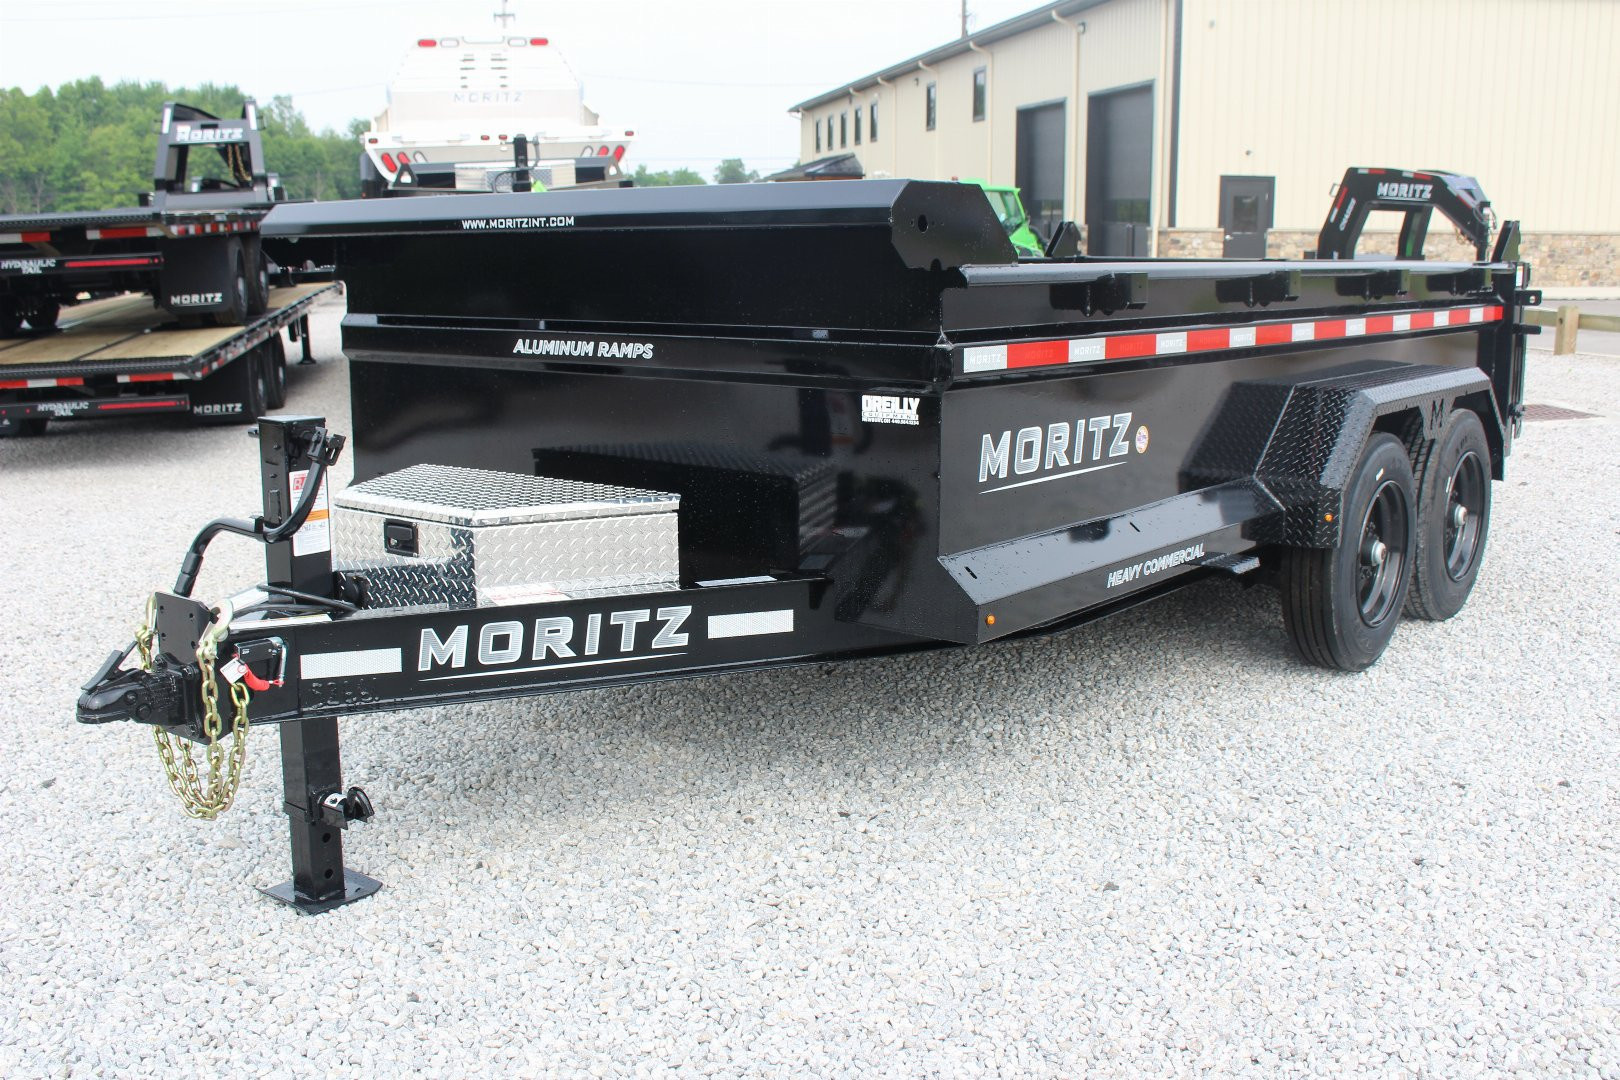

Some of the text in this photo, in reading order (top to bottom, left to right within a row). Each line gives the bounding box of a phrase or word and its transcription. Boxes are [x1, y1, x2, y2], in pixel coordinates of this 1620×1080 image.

[453, 91, 523, 103] MORITZ
[176, 125, 244, 142] MORITZ
[1376, 182, 1433, 199] MORITZ
[461, 216, 575, 230] WWW.MORITZINT.COM
[1, 259, 56, 269] HYDRAULIC
[22, 265, 42, 275] TAIL
[170, 292, 222, 305] MORITZ
[512, 338, 654, 360] ALUMINUM RAMPS
[968, 353, 1001, 366] MORITZ
[1074, 344, 1100, 356] MORITZ
[37, 402, 89, 412] HYDRAULIC
[54, 408, 73, 417] TAIL
[193, 403, 242, 415] MORITZ
[978, 412, 1133, 483] MORITZ
[1106, 542, 1205, 589] HEAVY COMMERCIAL
[417, 605, 692, 672] MORITZ
